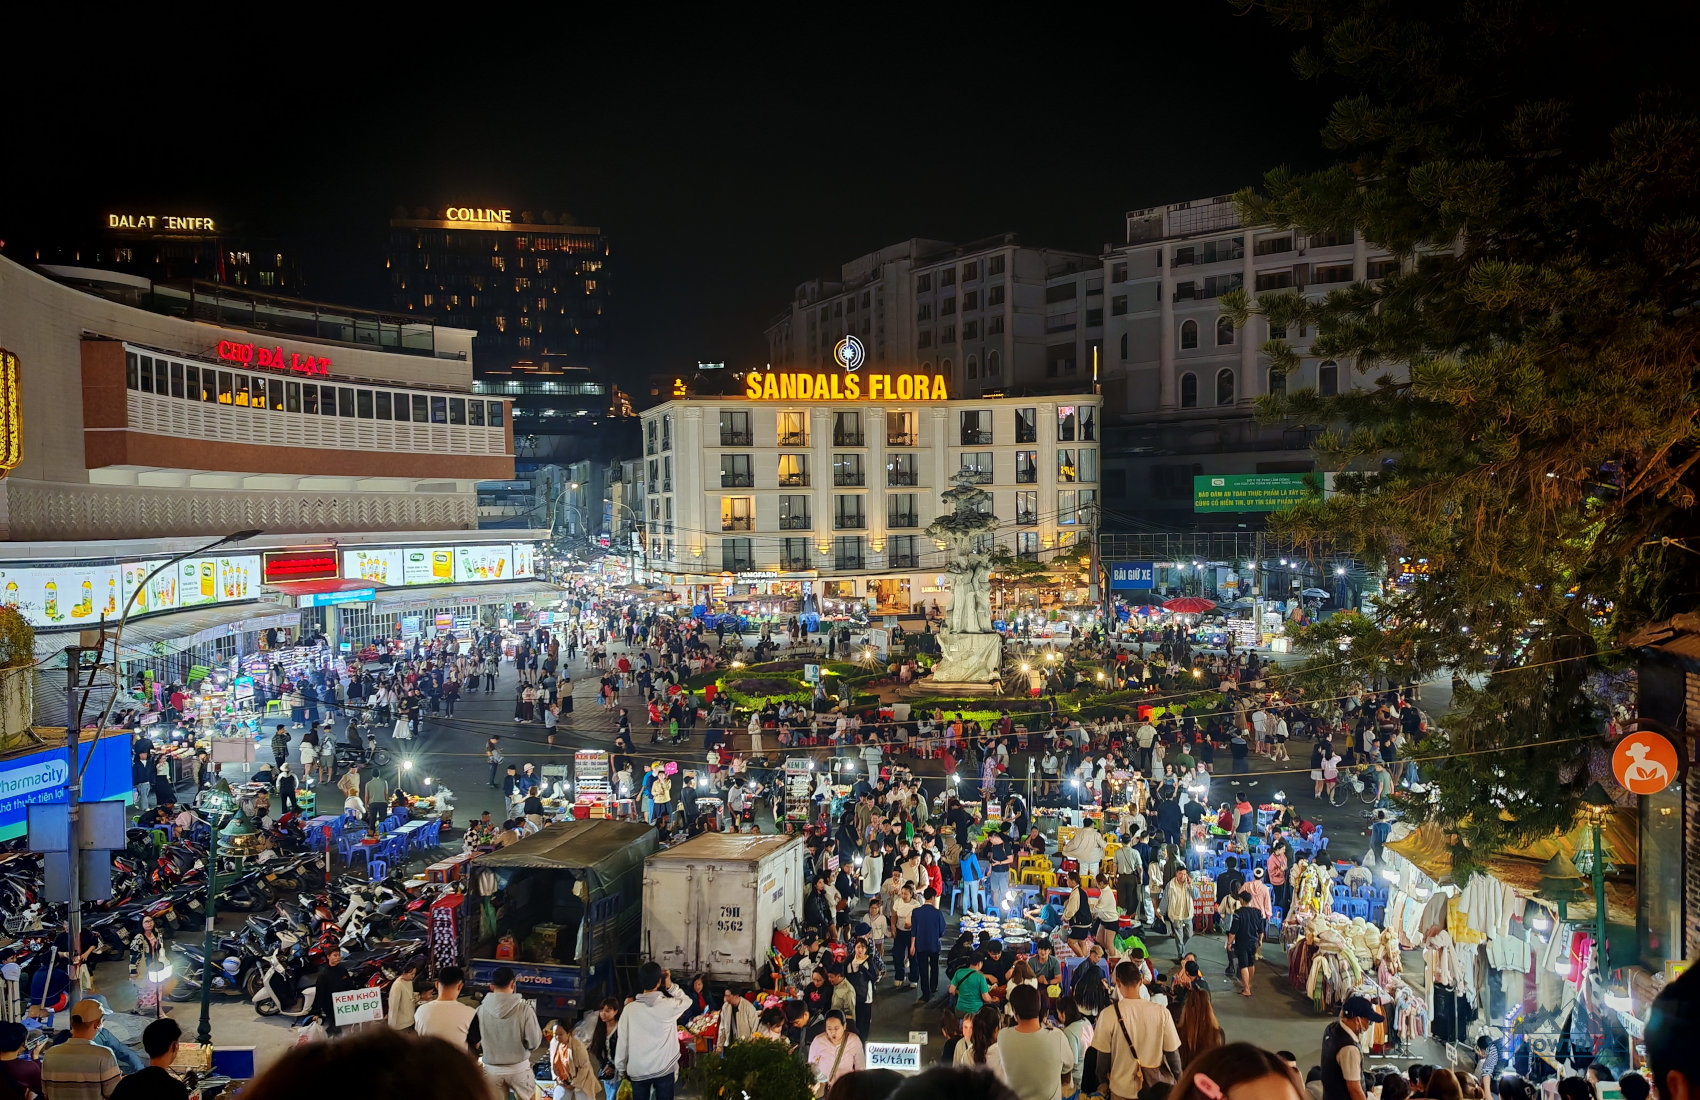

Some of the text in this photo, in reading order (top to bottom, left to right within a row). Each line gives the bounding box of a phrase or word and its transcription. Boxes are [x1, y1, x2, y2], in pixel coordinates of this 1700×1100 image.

[109, 214, 156, 229] DALAT
[446, 206, 511, 223] COLLINE
[218, 341, 332, 376] CHỢ ĐÀ LẠT
[746, 371, 948, 400] SANDALS FLORA
[1114, 567, 1152, 581] BÃI GIỮ XE
[0, 764, 63, 793] harmacity
[0, 801, 12, 813] hà
[720, 905, 741, 918] 79H
[717, 920, 744, 932] 9562
[335, 994, 355, 1004] KEM
[337, 1000, 380, 1015] KEM BƠ
[872, 1053, 915, 1065] 5k/tấm
